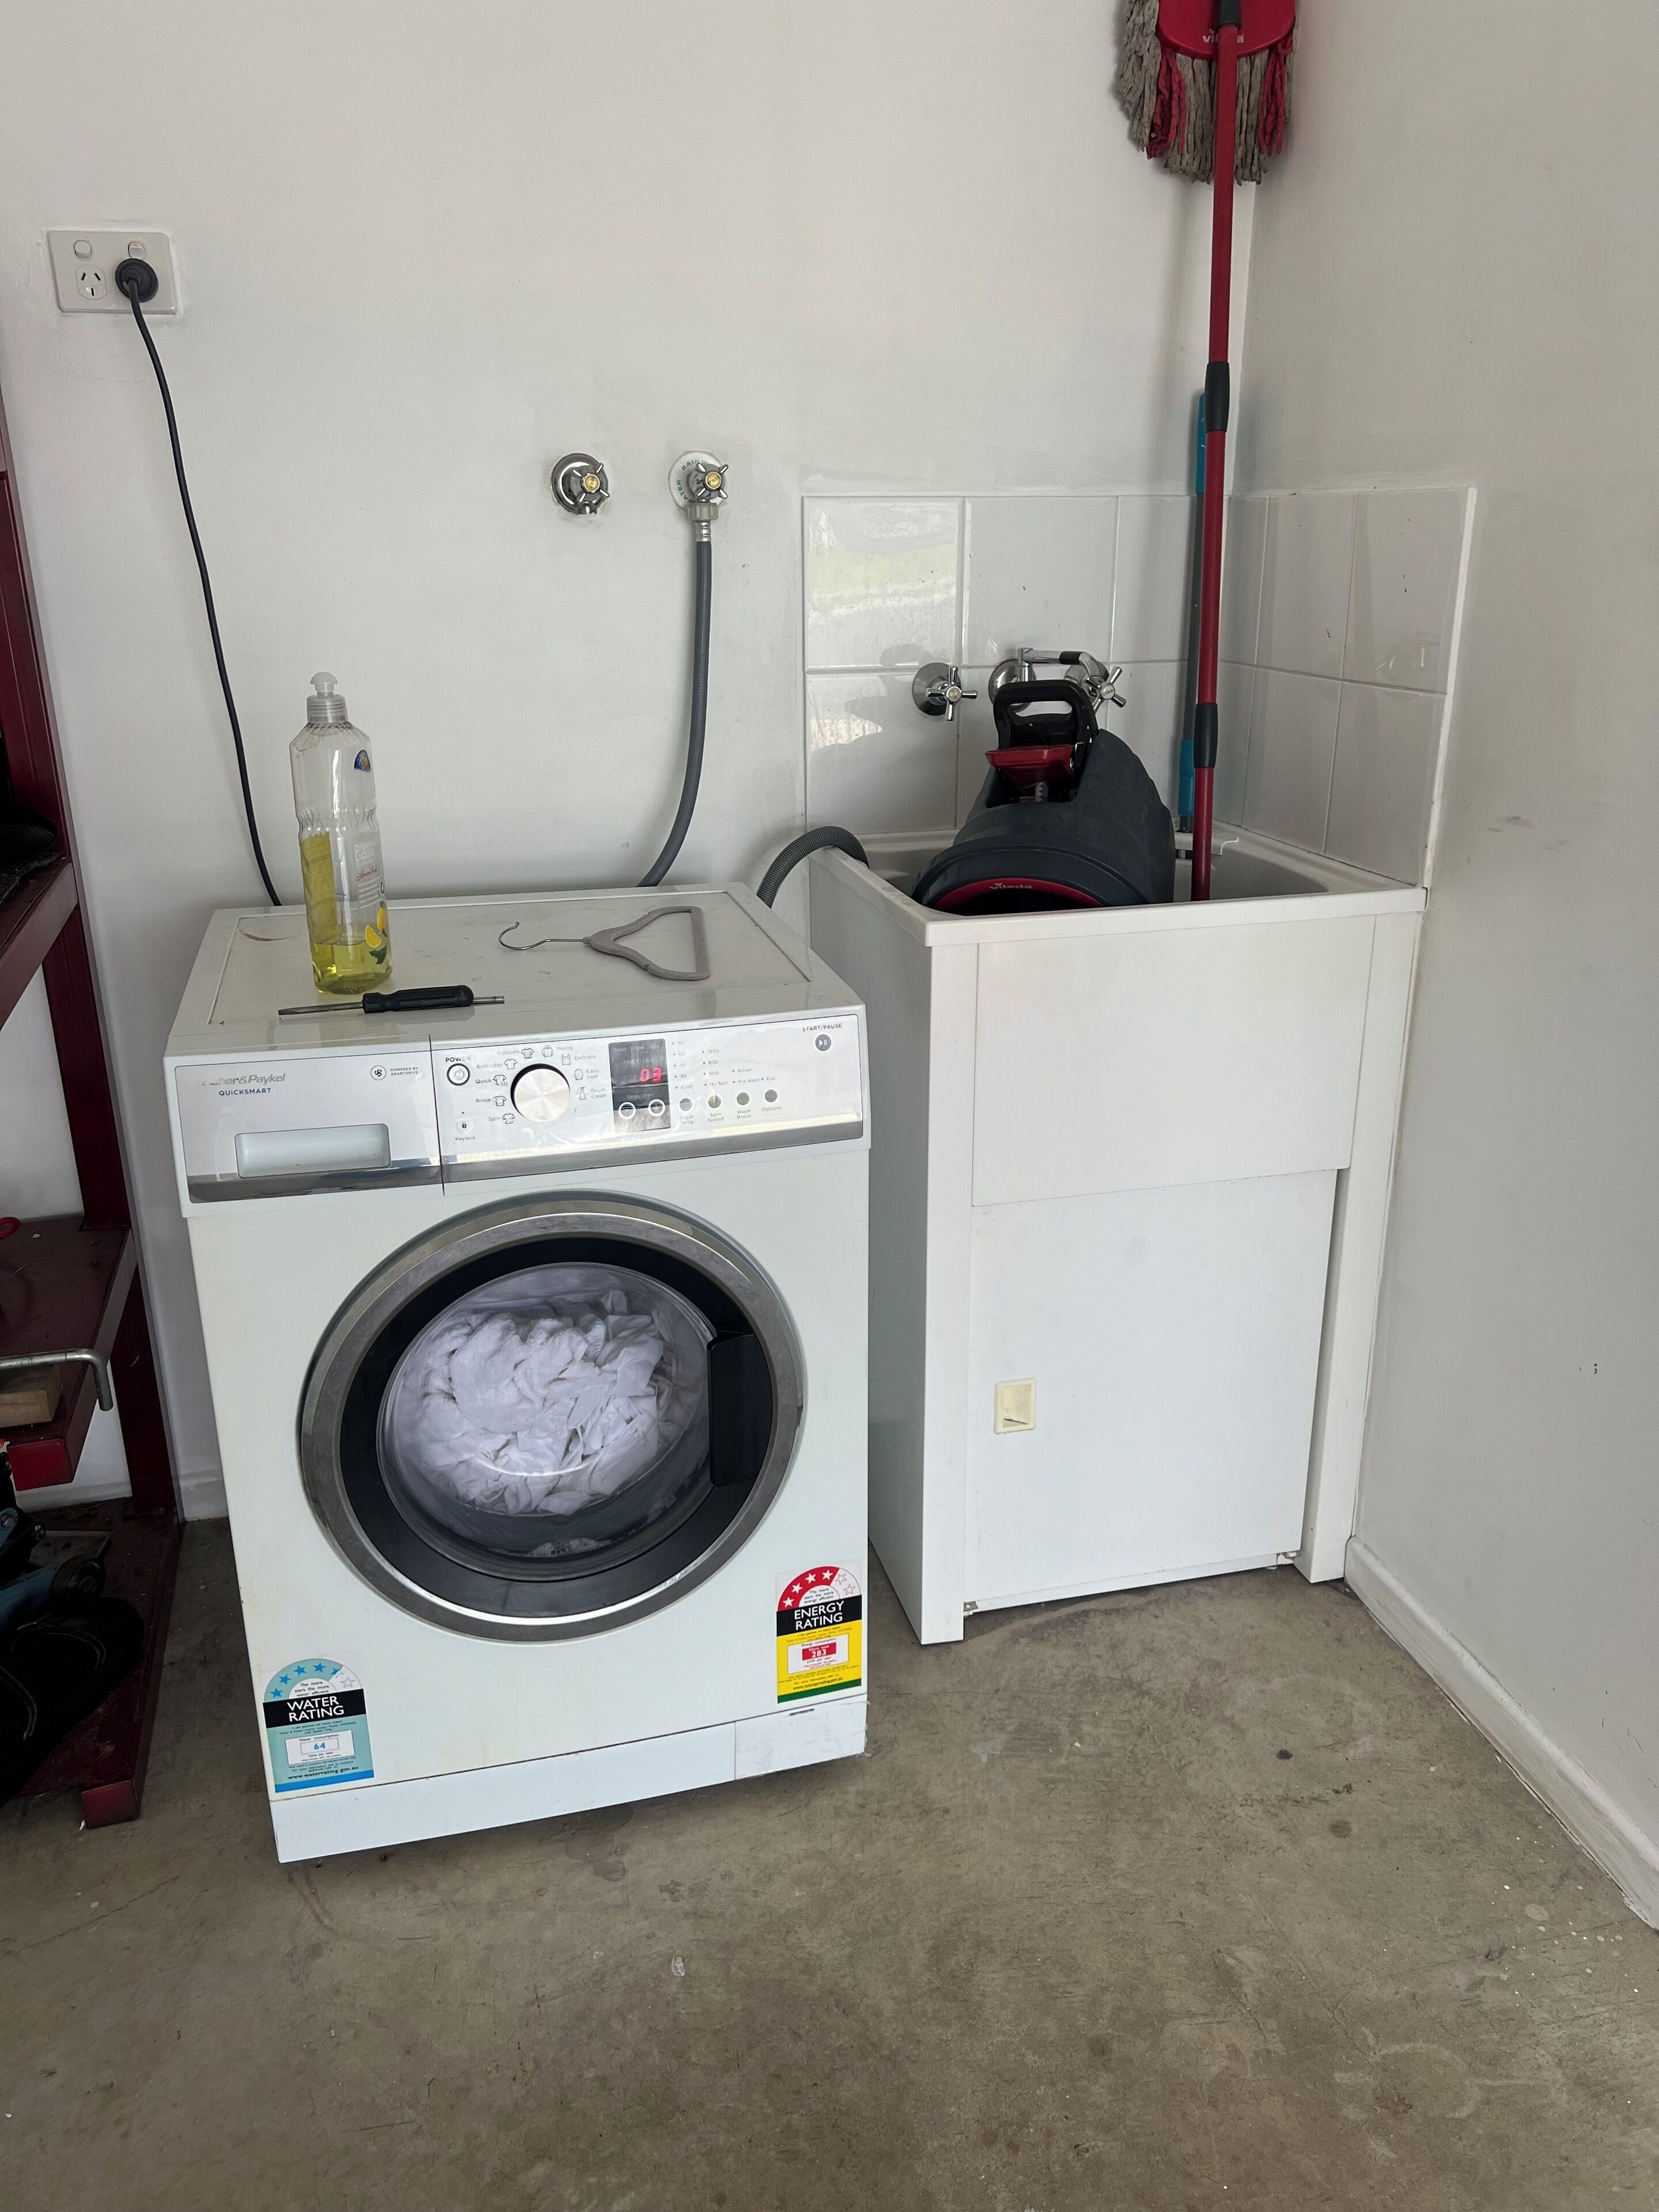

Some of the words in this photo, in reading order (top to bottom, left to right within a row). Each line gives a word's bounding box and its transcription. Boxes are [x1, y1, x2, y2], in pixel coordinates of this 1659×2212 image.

[1202, 29, 1244, 43] vila
[802, 1023, 842, 1032] START/PAUSE
[219, 1088, 271, 1096] QUICKSMART
[794, 1600, 844, 1620] ENERGY
[796, 1612, 843, 1631] RATING
[811, 1649, 827, 1658] 283
[287, 1696, 339, 1711] WATER
[289, 1705, 344, 1722] RATING
[313, 1742, 325, 1750] 64
